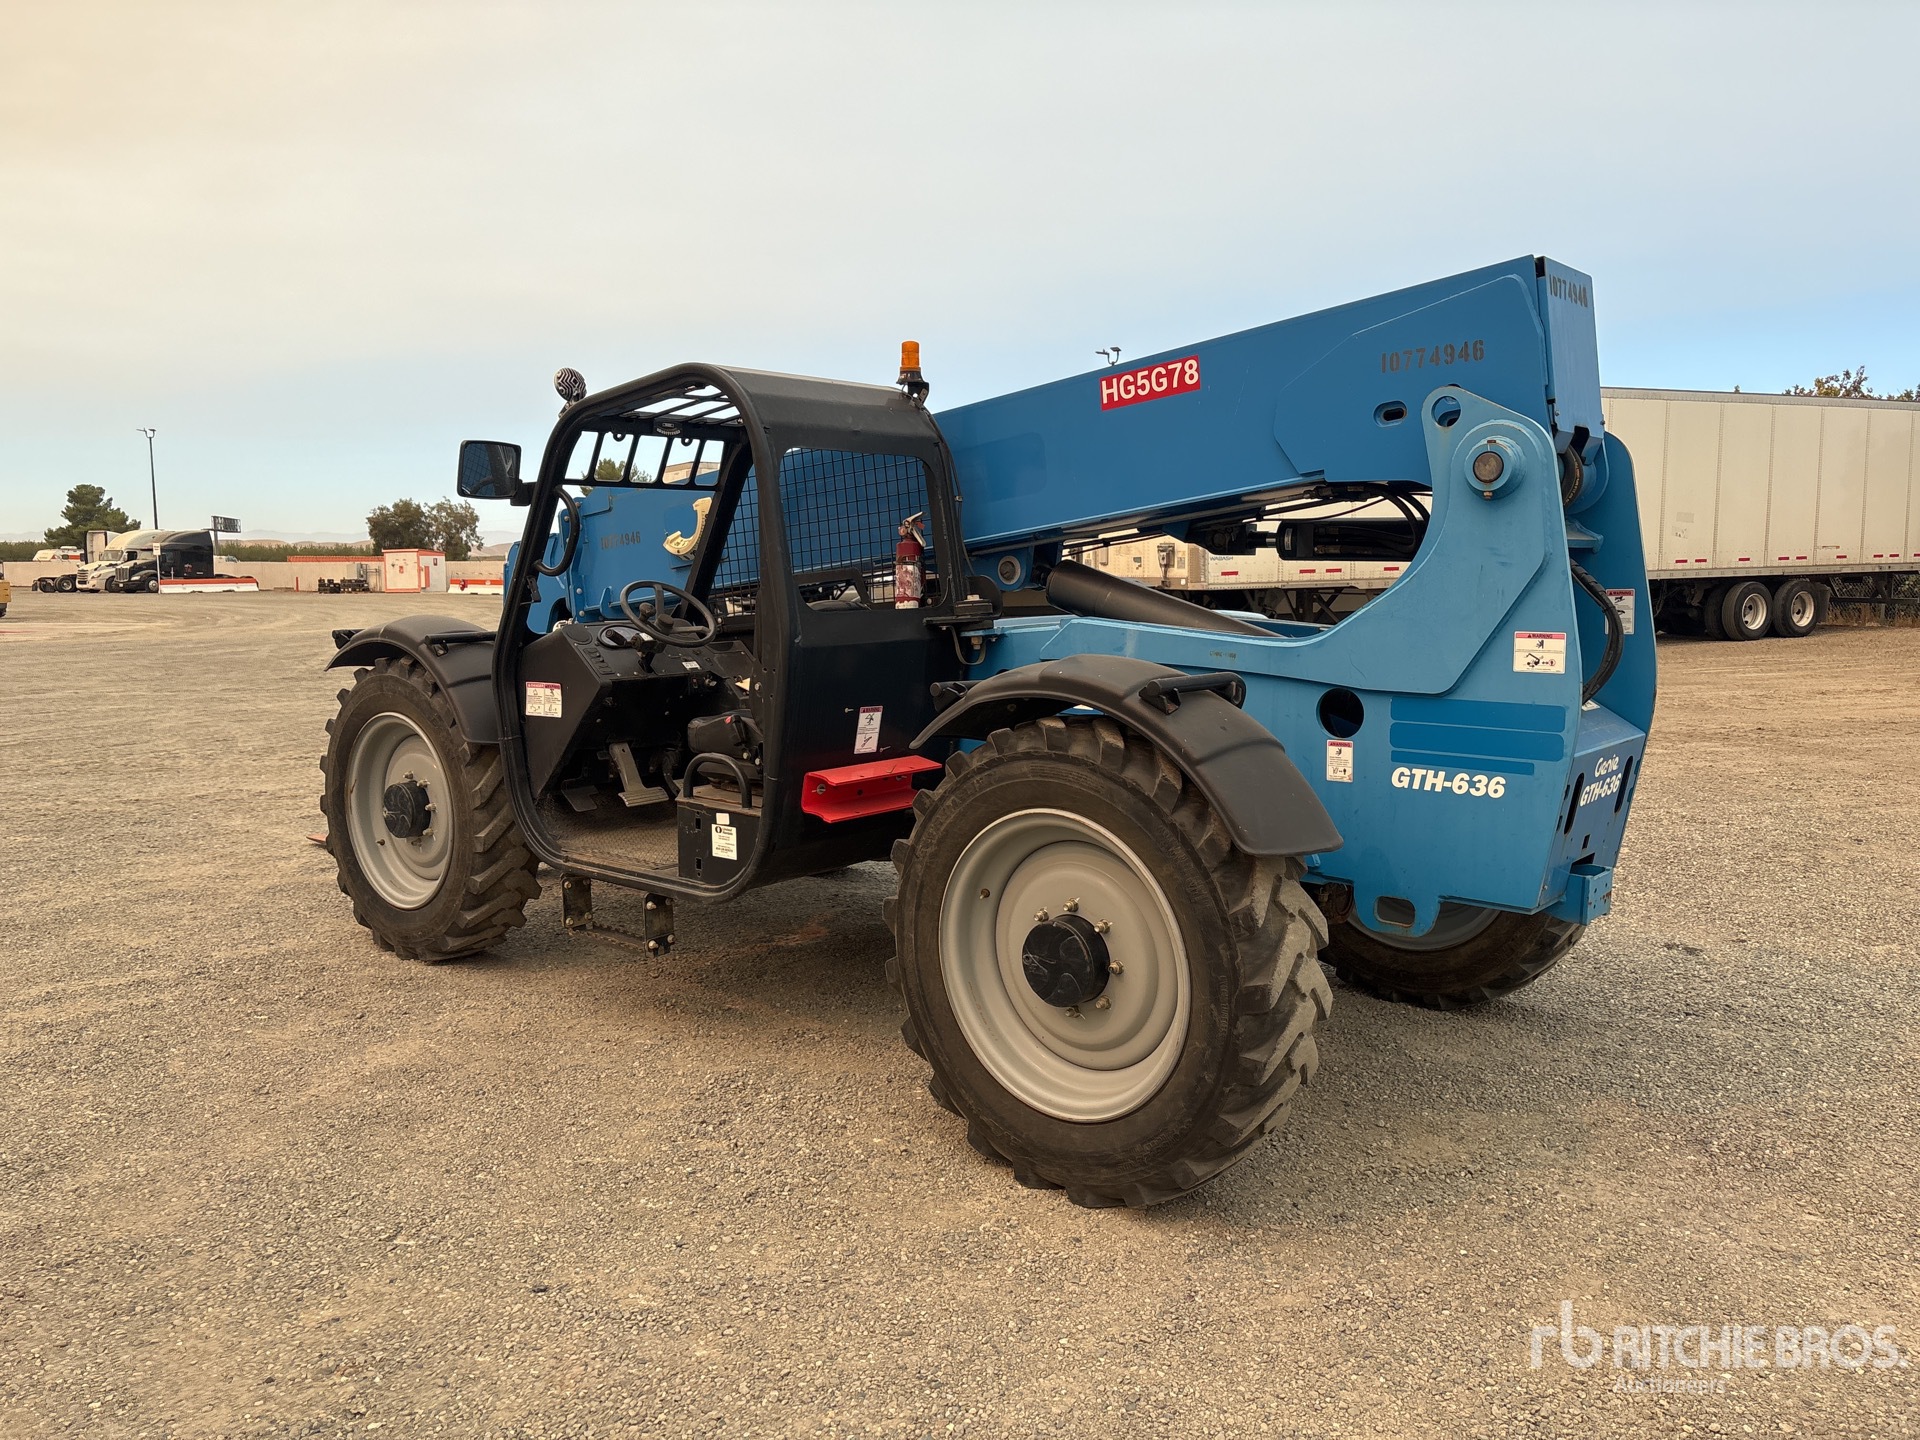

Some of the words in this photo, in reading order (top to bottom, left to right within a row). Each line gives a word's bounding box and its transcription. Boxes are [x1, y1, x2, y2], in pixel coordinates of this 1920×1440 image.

[1381, 339, 1485, 374] 10774946
[1101, 359, 1199, 404] HG5G78
[1391, 767, 1506, 799] GTH-636
[1580, 773, 1622, 807] GTH-636
